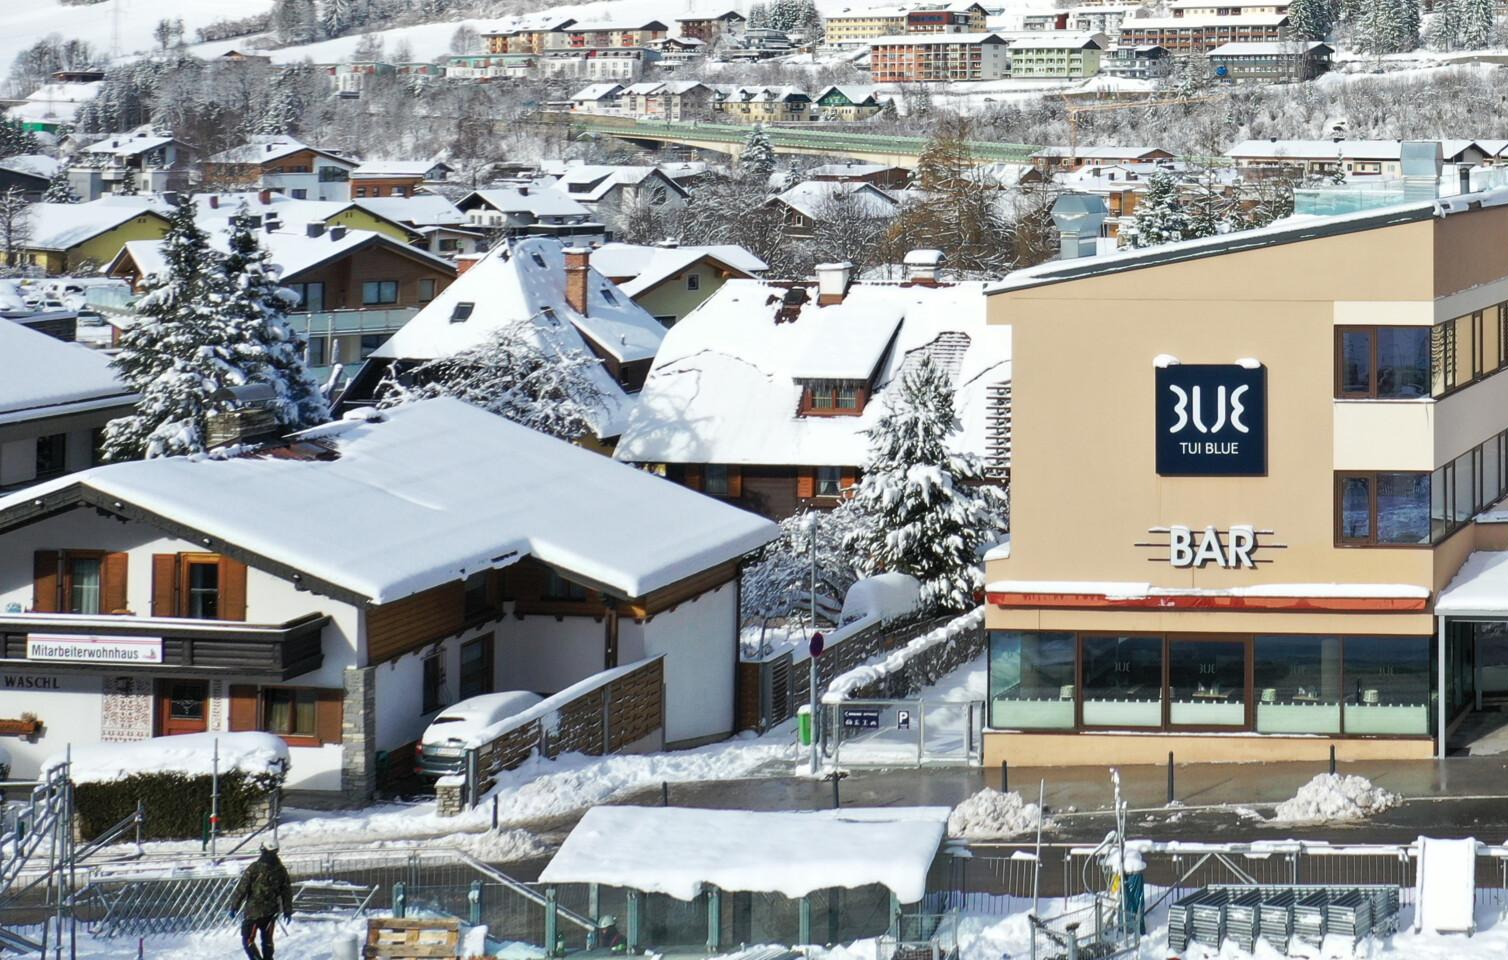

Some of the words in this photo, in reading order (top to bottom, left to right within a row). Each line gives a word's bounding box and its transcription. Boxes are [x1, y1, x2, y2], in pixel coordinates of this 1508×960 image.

[1179, 442, 1201, 455] TUI
[1205, 442, 1239, 455] BLUE
[1169, 525, 1257, 568] BAR
[31, 644, 139, 660] Mitarbeiterwohnhaus
[899, 711, 908, 723] P
